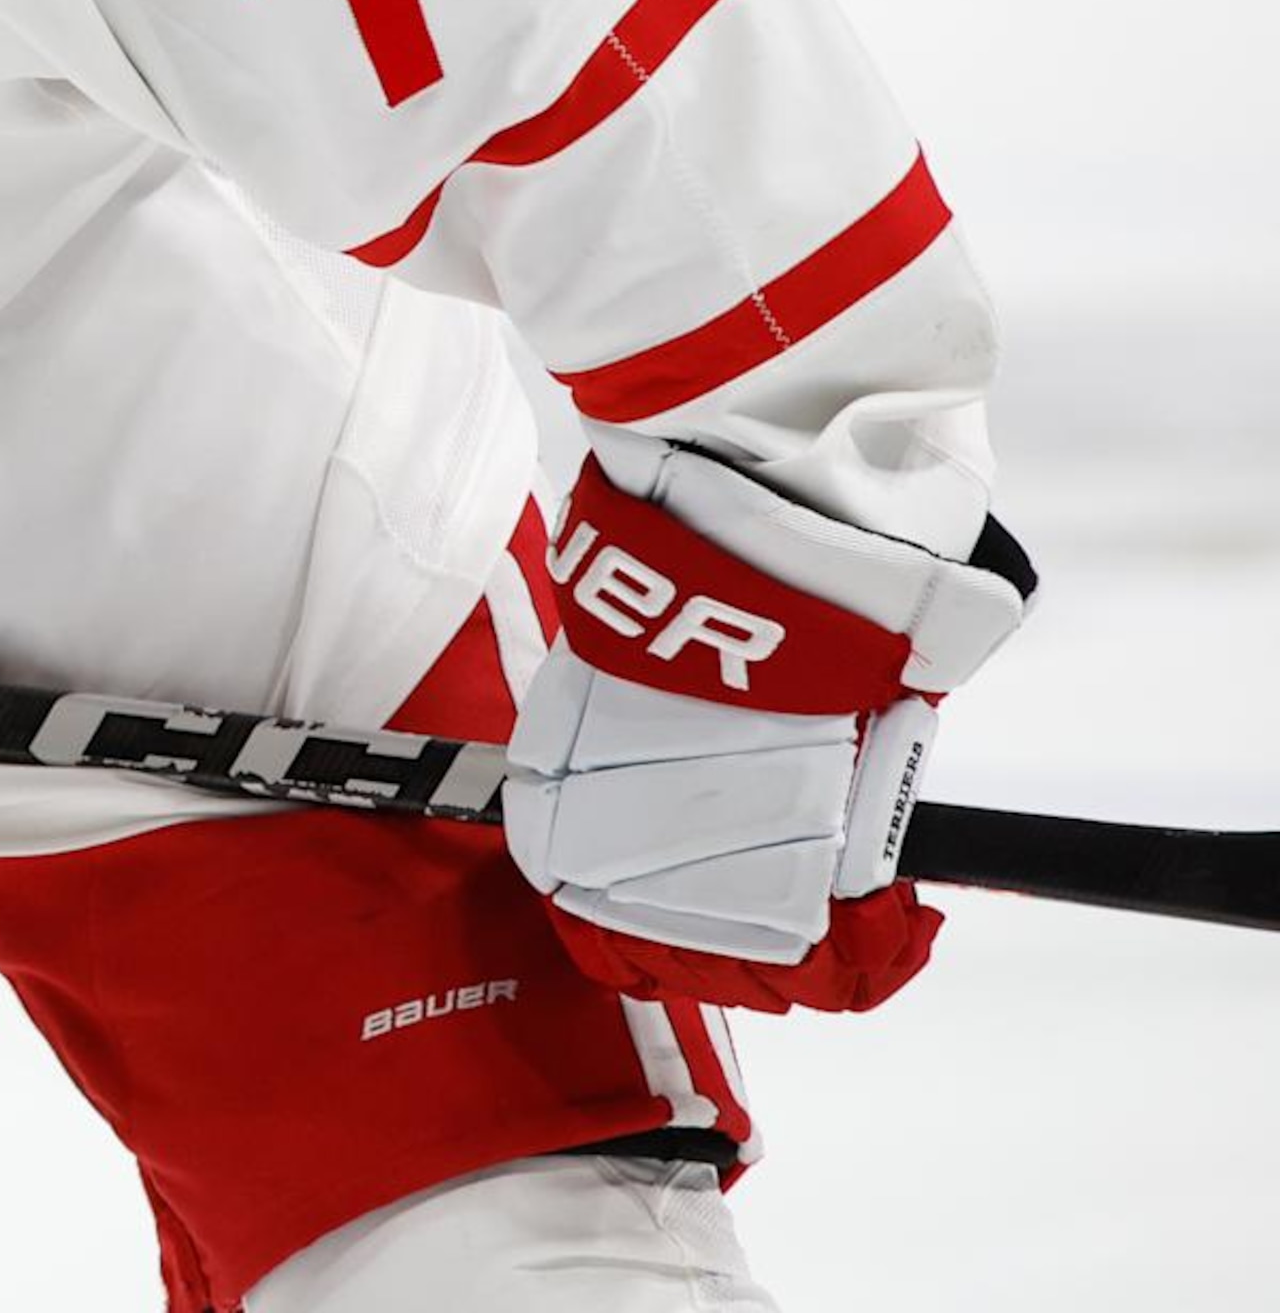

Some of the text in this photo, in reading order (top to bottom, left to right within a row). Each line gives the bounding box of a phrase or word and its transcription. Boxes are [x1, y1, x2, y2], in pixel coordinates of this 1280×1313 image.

[545, 496, 786, 692] UER
[883, 741, 924, 862] TERRIERS
[360, 978, 519, 1042] BAUER
